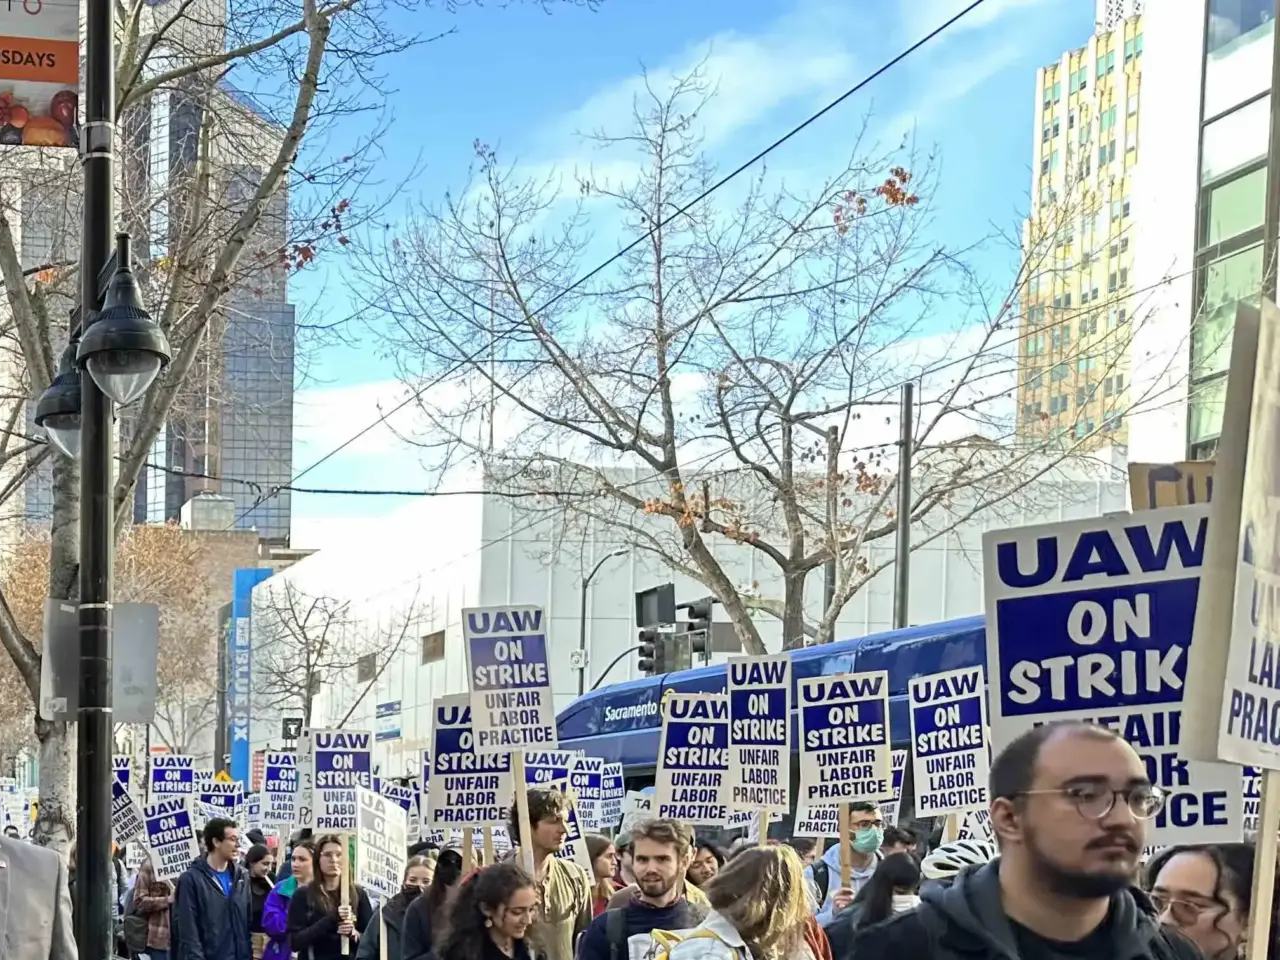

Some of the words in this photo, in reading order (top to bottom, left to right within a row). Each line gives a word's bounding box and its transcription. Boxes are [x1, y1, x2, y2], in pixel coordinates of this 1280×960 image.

[997, 517, 1208, 588] UAW
[468, 610, 542, 634] UAW
[1067, 593, 1150, 644] ON
[494, 640, 523, 661] ON
[475, 663, 546, 686] STRIKE
[731, 661, 787, 685] UAW
[1007, 644, 1183, 704] STRIK
[803, 677, 883, 702] UAW
[913, 672, 978, 703] UAW
[485, 691, 541, 709] UNFAIR
[747, 693, 769, 716] ON
[437, 706, 472, 725] UA
[489, 709, 540, 727] LABOR
[605, 700, 658, 721] Sacramento
[828, 705, 859, 725] ON
[934, 704, 960, 727] ON
[479, 726, 553, 746] PRACTICE
[688, 726, 714, 744] ON
[732, 718, 785, 741] STRIKE
[807, 724, 883, 747] STRIKE
[316, 733, 369, 748] UAW
[459, 732, 473, 749] O
[917, 724, 981, 753] STRIKE
[154, 758, 193, 767] UAW
[268, 755, 296, 765] UA
[332, 754, 353, 769] ON
[437, 752, 508, 771] STRIKE
[525, 753, 570, 765] UAW
[574, 761, 601, 771] AW
[740, 749, 779, 766] UNFAIR
[817, 749, 875, 767] UNFAIR
[926, 753, 975, 774] UNFAIR
[165, 771, 180, 780] ON
[279, 769, 295, 780] ON
[317, 771, 369, 786] STRIKE
[535, 770, 553, 780] ON
[603, 766, 620, 776] AW
[741, 768, 777, 785] LABOR
[820, 765, 873, 782] LABOR
[153, 782, 192, 791] STRIKE
[202, 784, 236, 793] UAW
[267, 780, 296, 792] STRI
[444, 776, 499, 791] UNFAIR
[572, 775, 589, 785] ON
[604, 779, 615, 788] ON
[671, 773, 721, 787] UNFAIR
[930, 772, 973, 791] LABOR
[324, 791, 356, 802] UNFAI
[672, 789, 717, 802] LABOR
[733, 786, 786, 805] PRACTICE
[808, 779, 887, 799] PRACTICE
[211, 797, 224, 805] ON
[271, 794, 293, 802] UNFA
[446, 791, 496, 806] LABOR
[921, 788, 986, 810] PRACTICE
[144, 799, 185, 817] UAW
[265, 811, 295, 820] PRACTI
[326, 804, 355, 815] LABO
[434, 807, 507, 822] PRACTICE
[659, 805, 727, 819] PRACTICE
[808, 809, 839, 820] LABO
[116, 815, 138, 834] LABOR
[160, 816, 177, 829] ON
[317, 817, 356, 828] PRACTI
[798, 821, 839, 832] PRACTI
[151, 827, 192, 848] STRIKE
[158, 842, 190, 856] UNFAIR
[162, 852, 190, 865] LABOR
